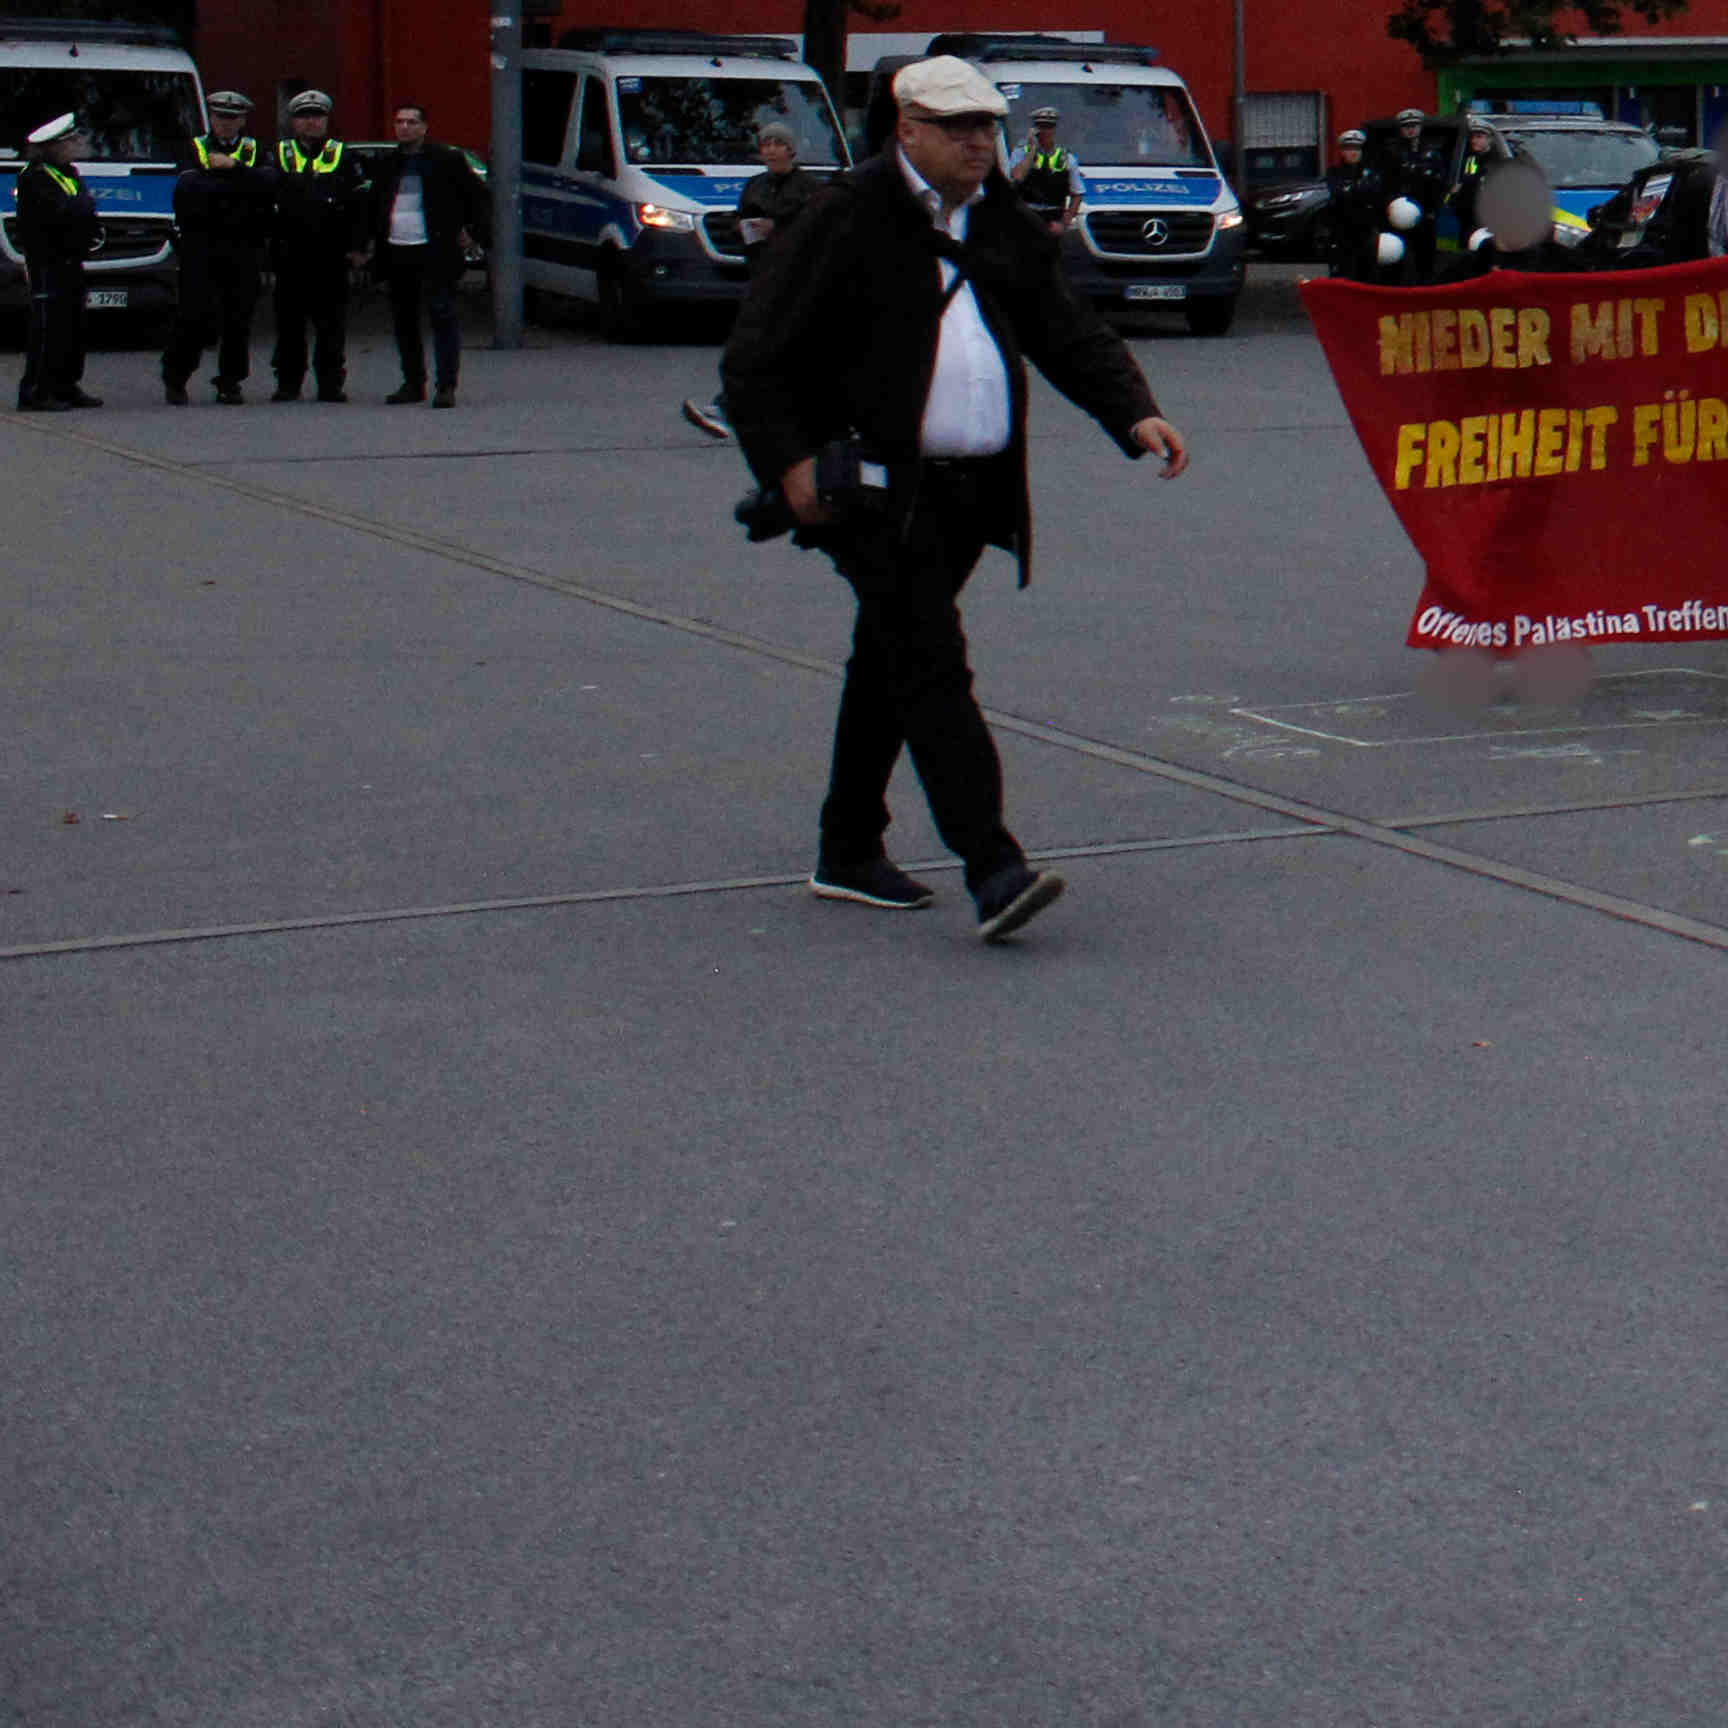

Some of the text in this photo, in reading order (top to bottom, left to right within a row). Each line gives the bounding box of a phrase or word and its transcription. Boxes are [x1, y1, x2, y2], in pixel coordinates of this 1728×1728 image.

[1094, 182, 1191, 195] POLIZEI
[1376, 306, 1553, 376] NIEDER
[1569, 297, 1665, 367] MIT
[1393, 404, 1619, 491] FREIHEIT
[1416, 604, 1510, 648] Offenes
[1512, 609, 1641, 646] Palästina
